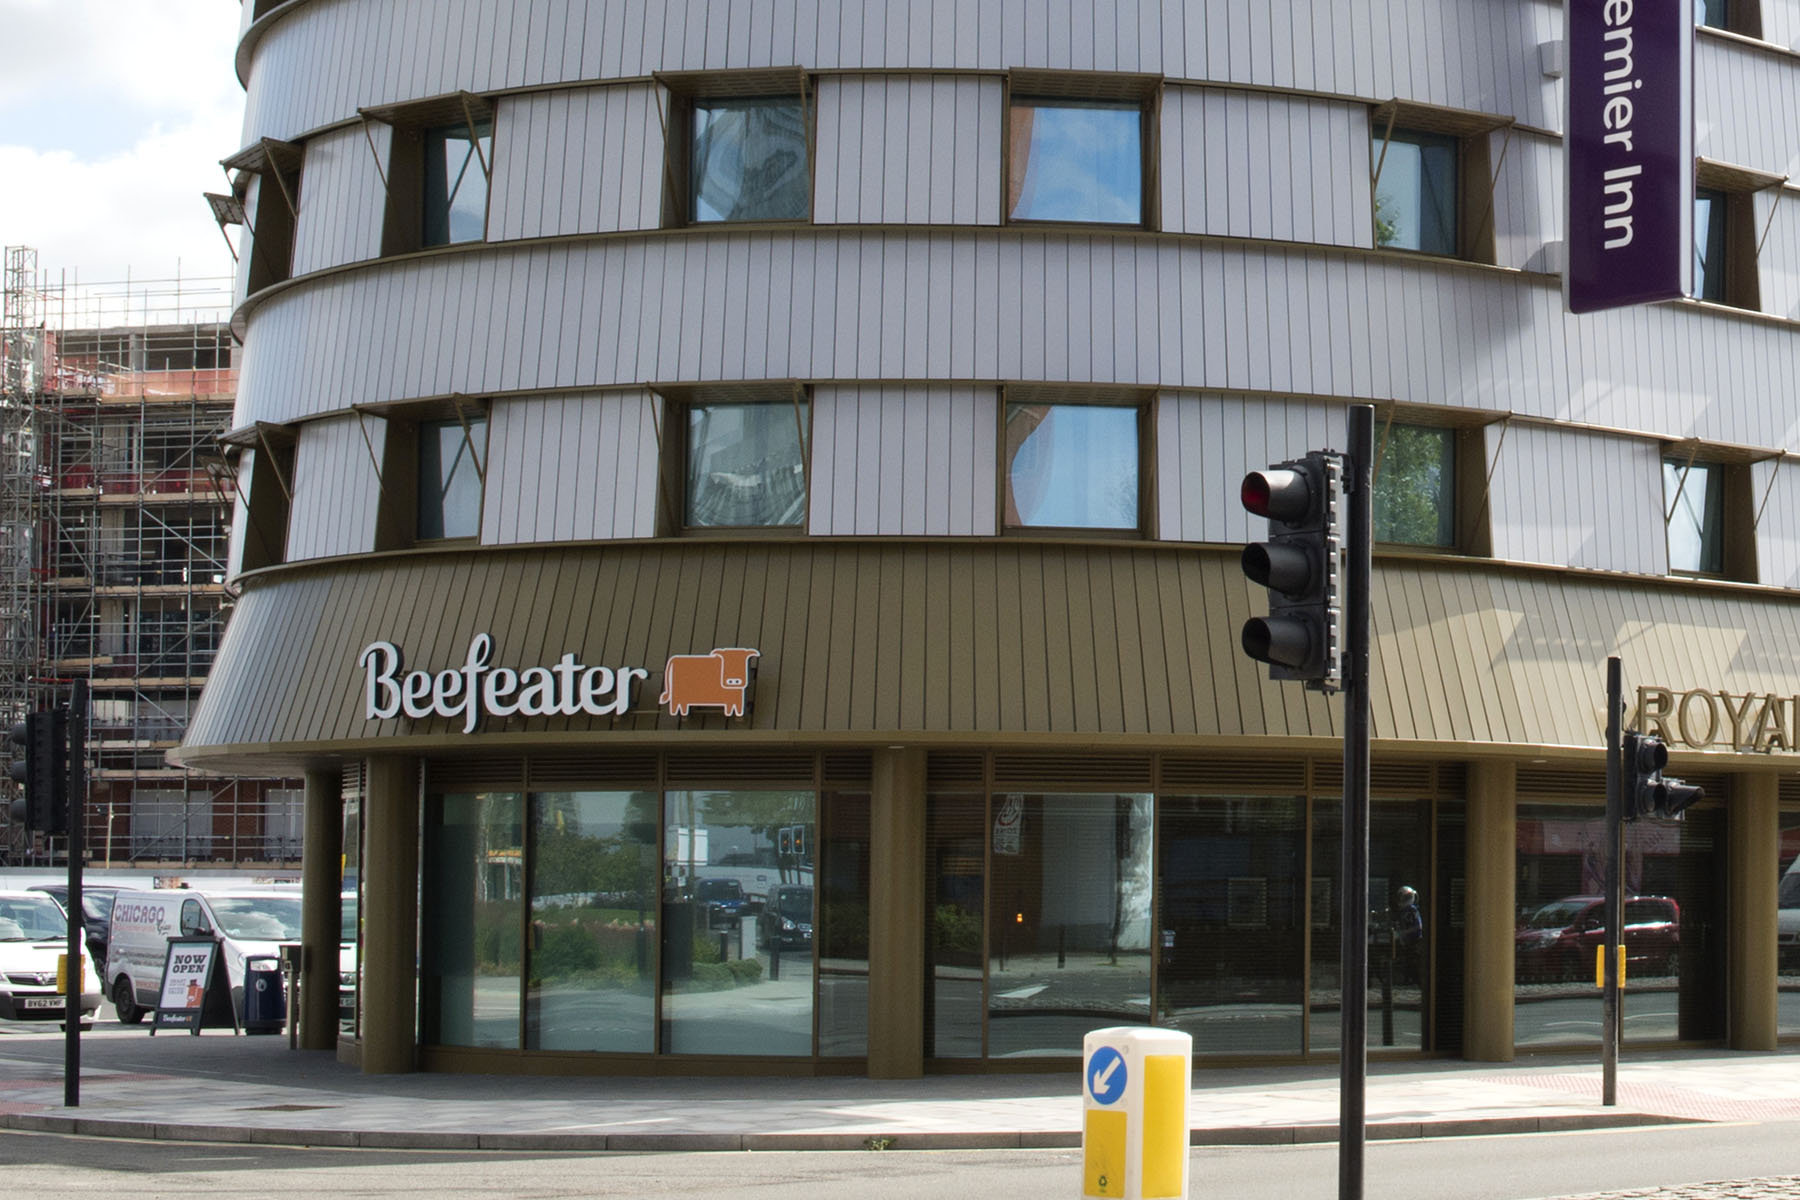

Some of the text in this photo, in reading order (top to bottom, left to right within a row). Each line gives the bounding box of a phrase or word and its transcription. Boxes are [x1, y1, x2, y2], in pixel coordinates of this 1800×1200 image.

[1603, 163, 1643, 250] Inn
[359, 632, 648, 735] Beefeater
[114, 904, 165, 924] CHICAGO
[172, 965, 205, 974] OPEN
[174, 954, 207, 965] NOW
